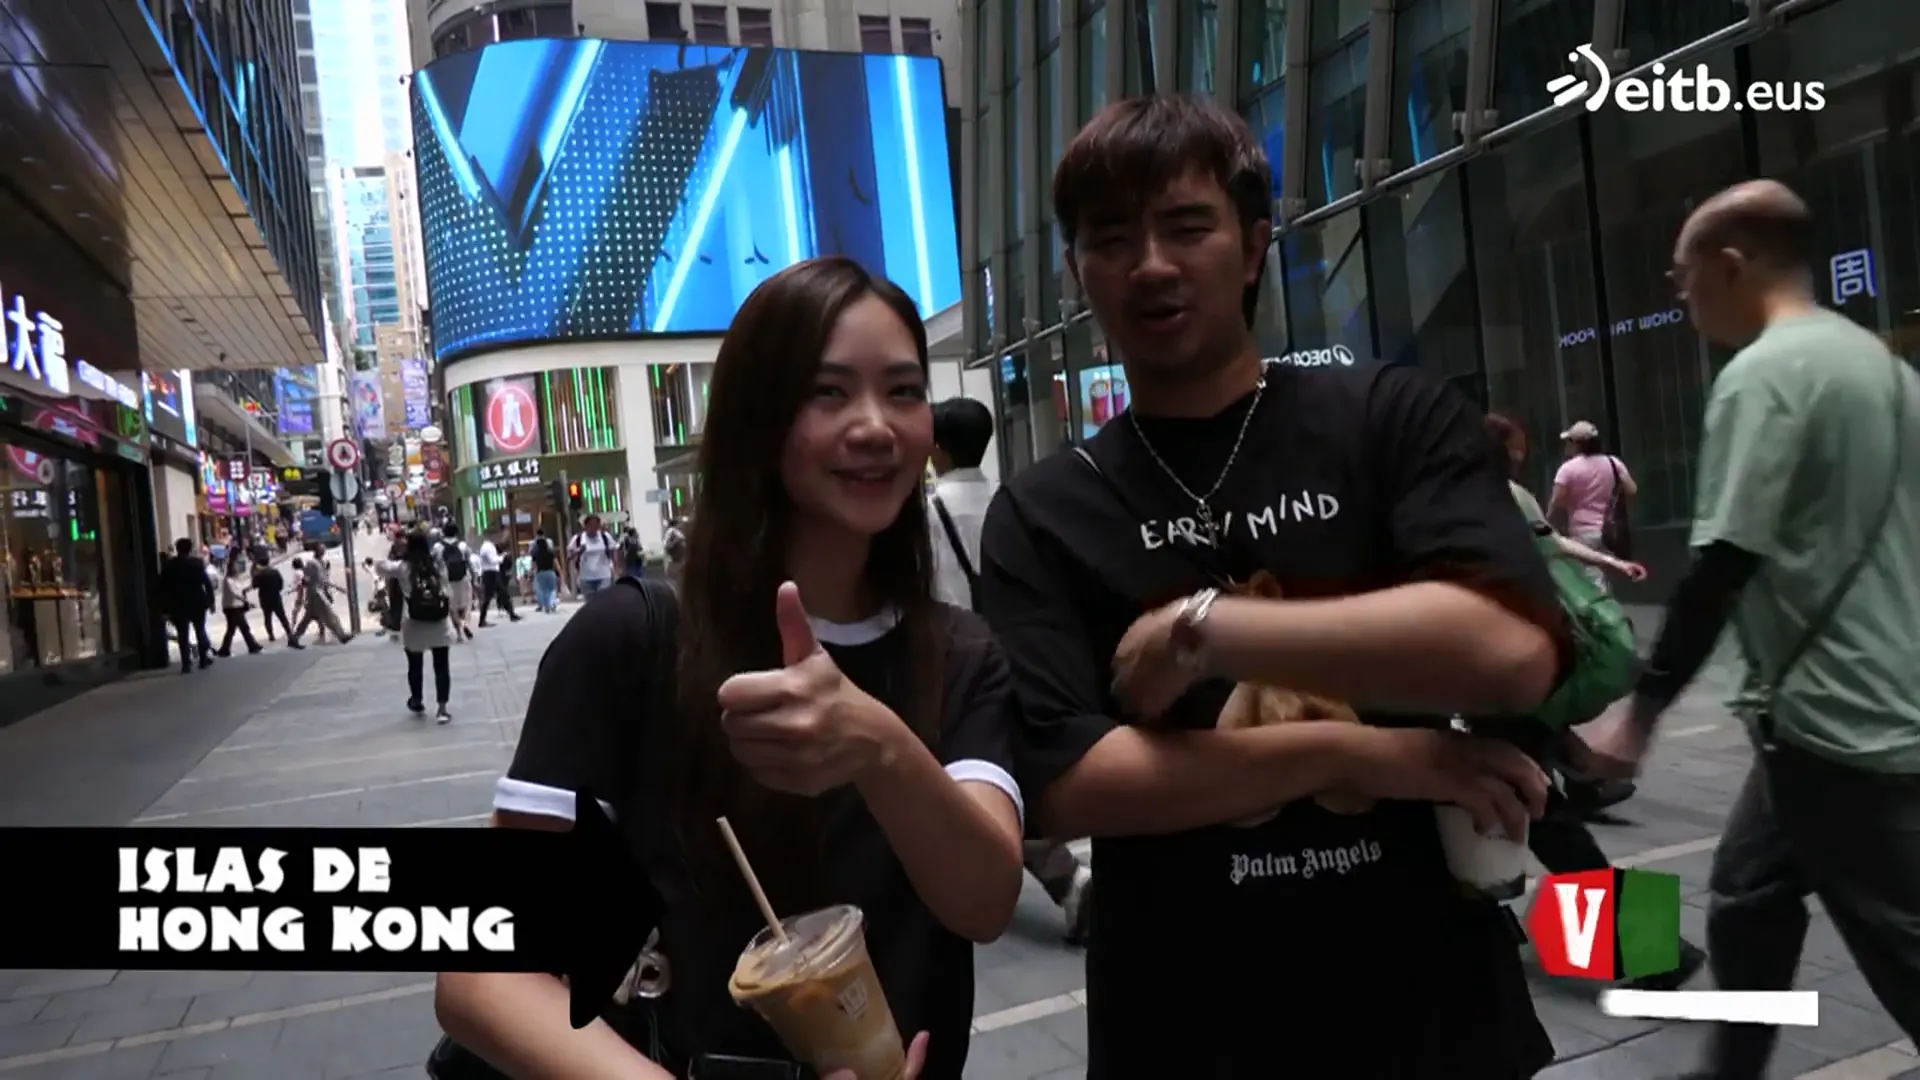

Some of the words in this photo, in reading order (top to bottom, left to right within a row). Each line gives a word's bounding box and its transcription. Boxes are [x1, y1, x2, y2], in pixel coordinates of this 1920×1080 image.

[1246, 489, 1340, 540] MIND
[1229, 852, 1298, 885] Palm
[1301, 838, 1382, 880] Angels
